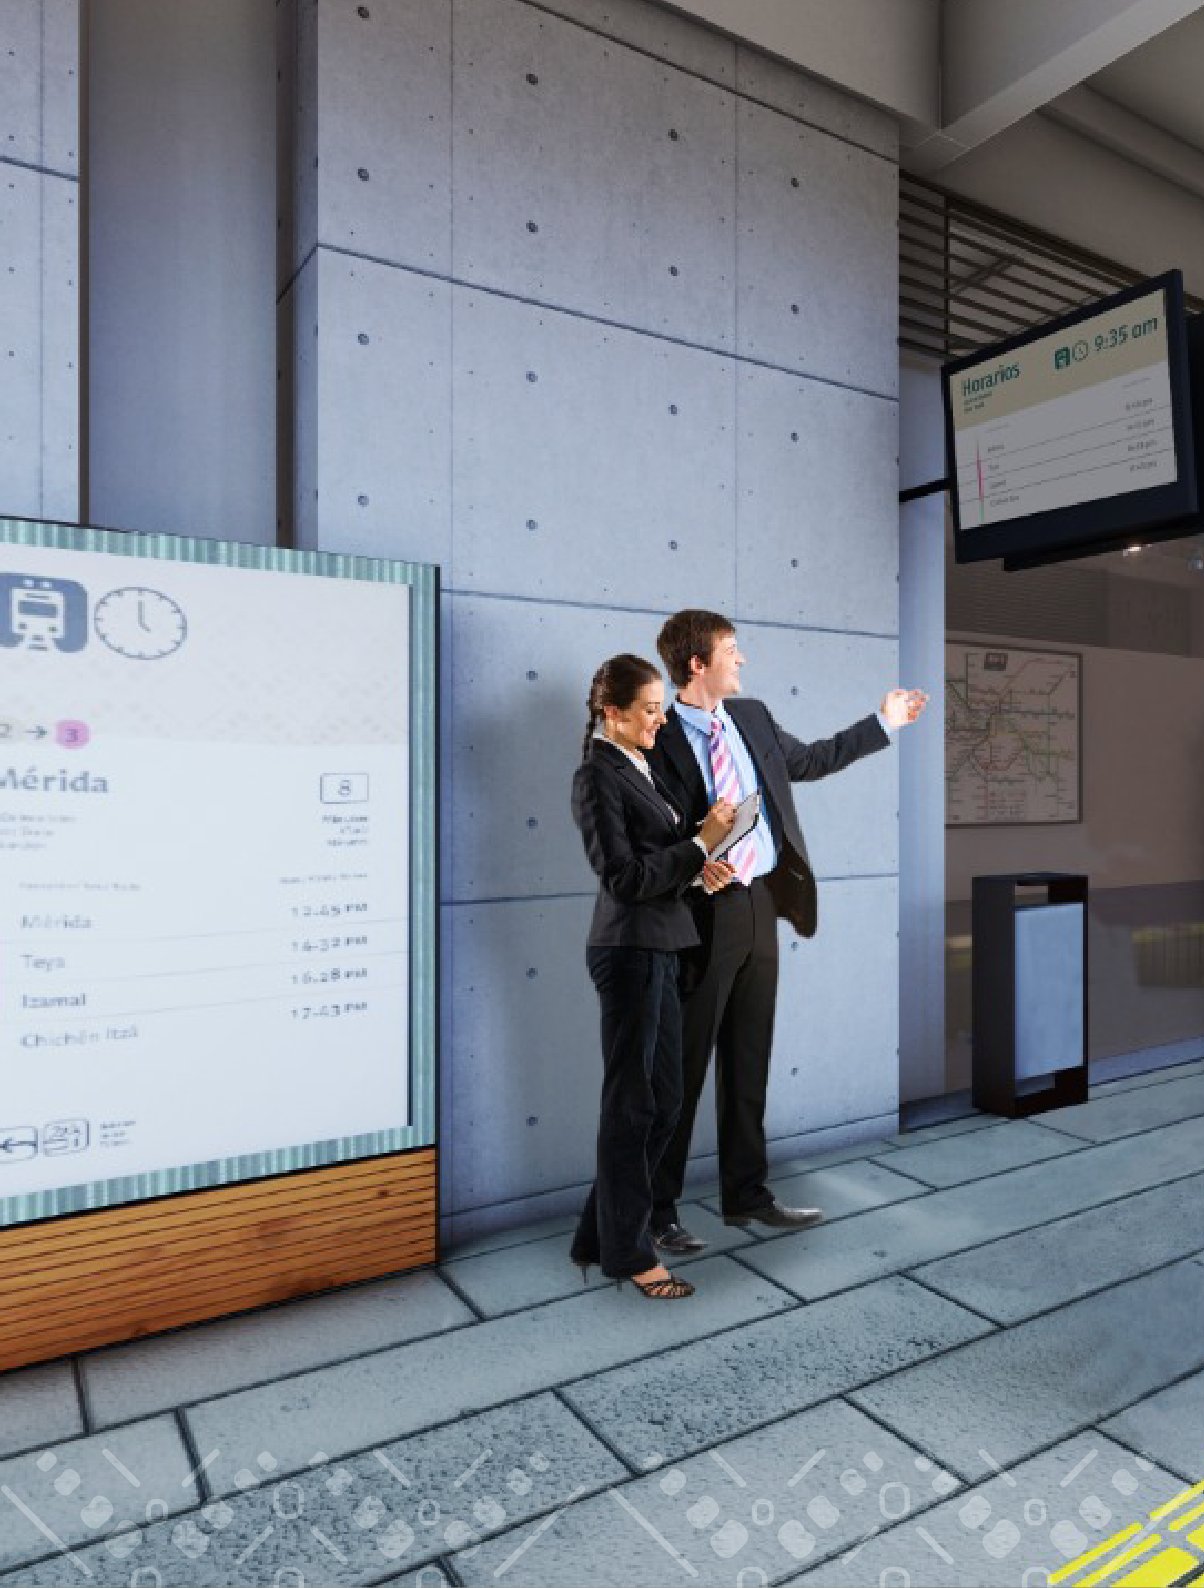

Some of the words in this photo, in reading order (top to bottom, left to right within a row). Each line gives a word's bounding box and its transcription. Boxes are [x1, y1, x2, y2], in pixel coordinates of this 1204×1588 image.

[1095, 325, 1128, 351] 9:35
[961, 361, 1021, 397] Horarios
[65, 728, 79, 743] 3
[21, 952, 66, 973] Teya
[21, 993, 87, 1009] Izamal
